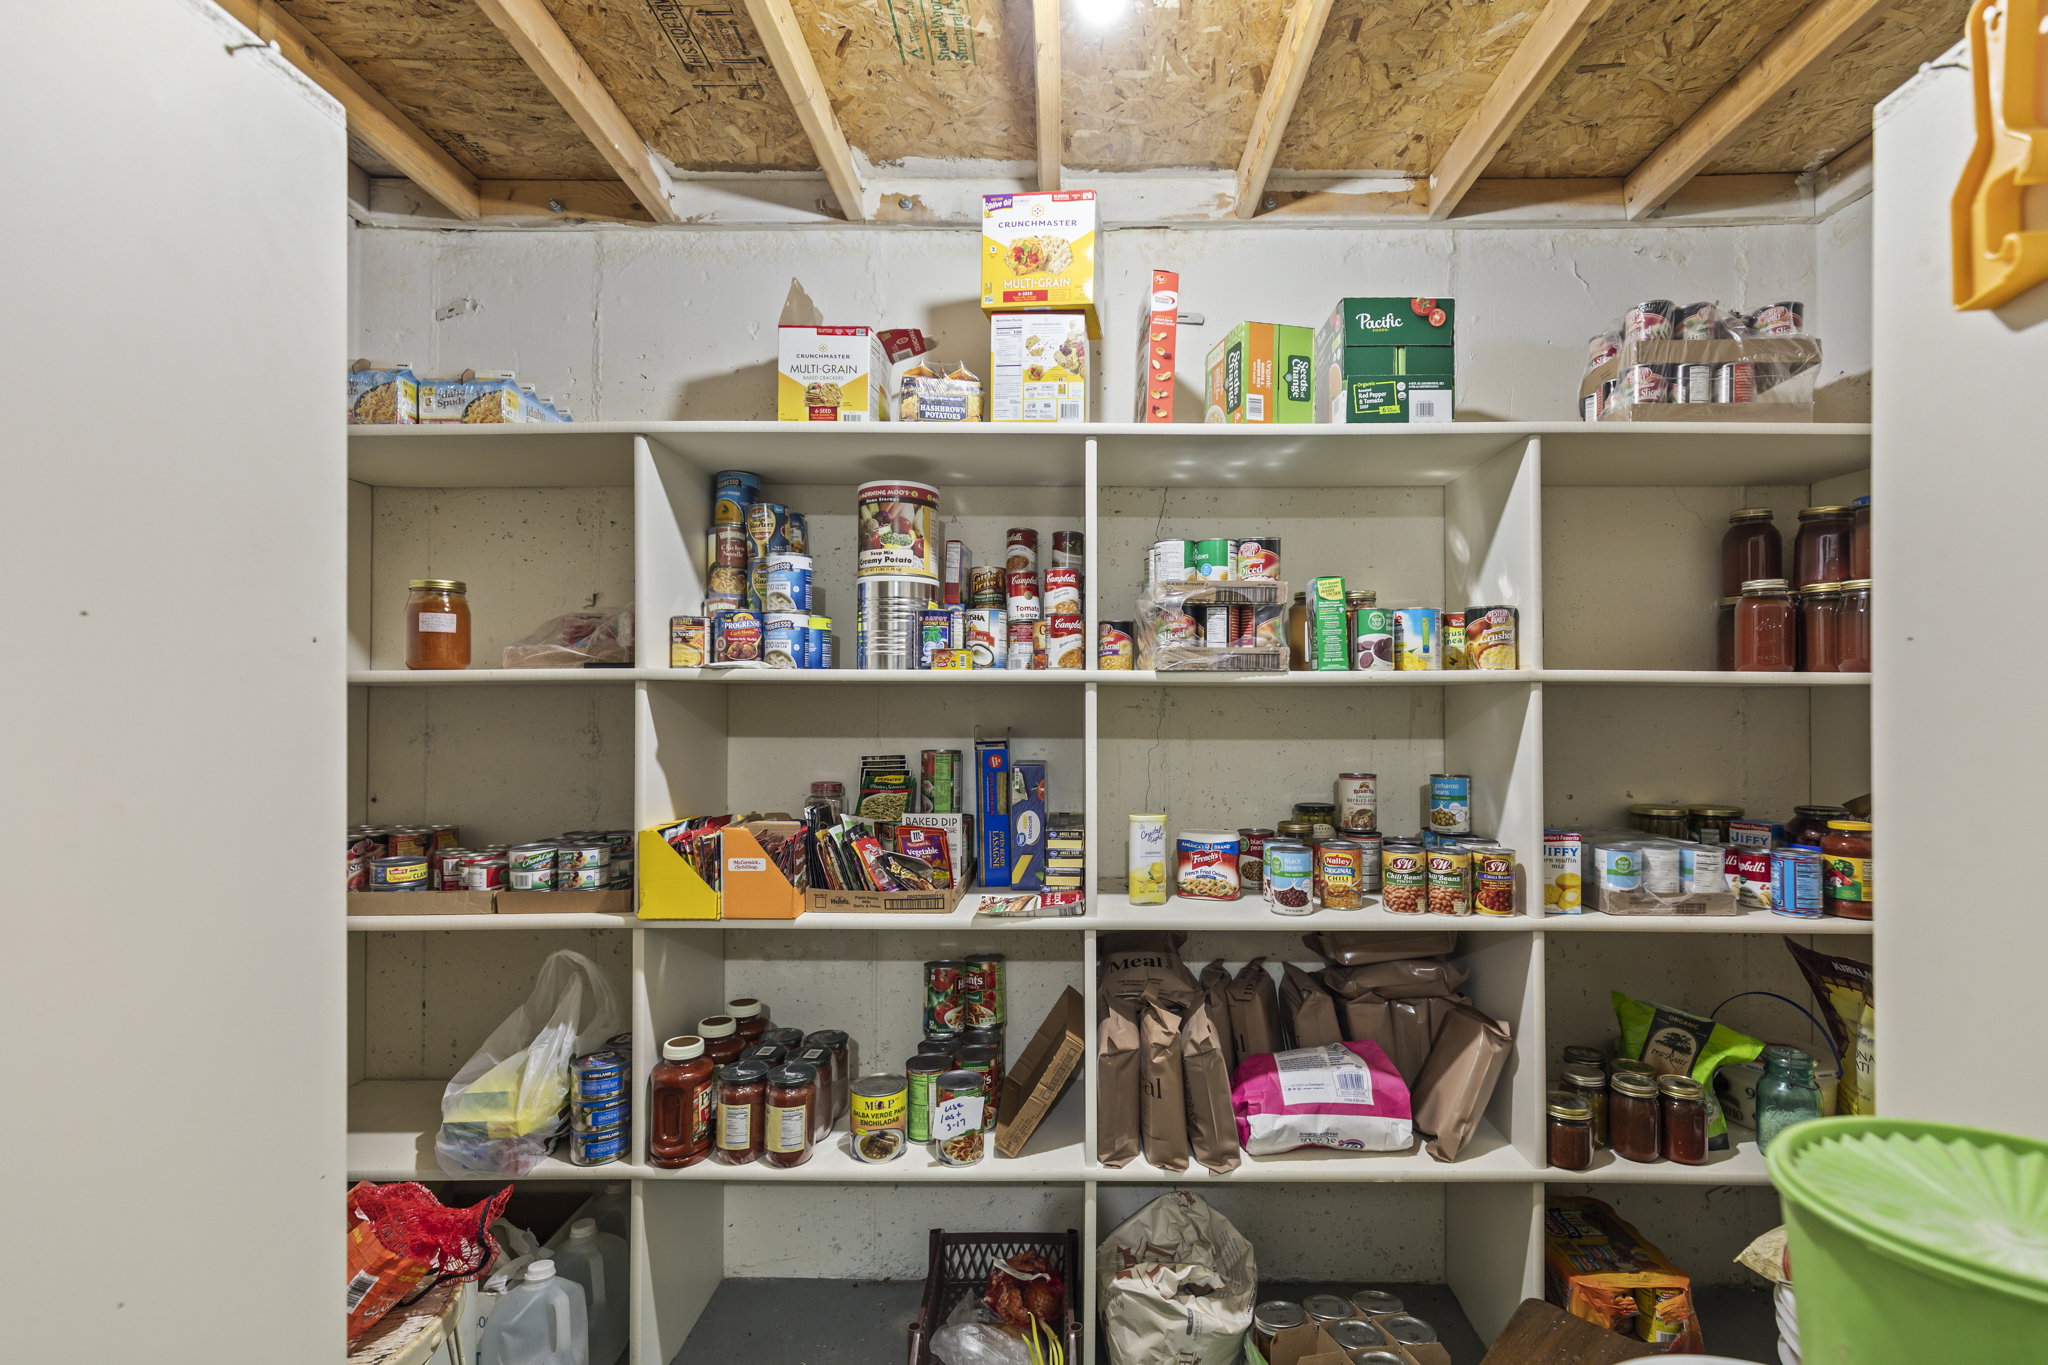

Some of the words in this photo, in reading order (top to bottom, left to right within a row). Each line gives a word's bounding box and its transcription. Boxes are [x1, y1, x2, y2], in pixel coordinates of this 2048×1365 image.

[666, 22, 692, 46] SIDE
[998, 220, 1078, 228] CRUNCHMASTER
[1003, 277, 1071, 288] MULTI-GRAIN
[1356, 312, 1404, 330] Pacific
[790, 364, 858, 374] MULTI-GRAIN
[1291, 358, 1302, 398] Change
[1300, 361, 1309, 392] Seeds
[437, 388, 466, 400] Idaho
[437, 398, 466, 408] Spuds
[920, 402, 966, 414] HASHBROWN
[924, 411, 961, 421] POTATOES
[861, 490, 886, 498] MORNING
[860, 558, 882, 566] Creamy
[884, 556, 912, 564] Potato
[1240, 564, 1263, 576] Diced
[1046, 572, 1076, 584] Campbell's
[1158, 630, 1186, 640] Sliced
[1480, 628, 1514, 643] Crushed
[906, 817, 938, 826] BAKED
[942, 818, 958, 826] DIP
[1140, 826, 1162, 842] Crystal
[1148, 832, 1164, 845] Light
[1731, 831, 1769, 846] JIFFY
[1182, 842, 1204, 850] AMERICA'S
[907, 847, 940, 858] Vegetable
[1192, 852, 1219, 864] French's
[1284, 856, 1302, 864] black
[1326, 857, 1352, 866] Nalley
[1184, 869, 1200, 878] French
[1212, 870, 1228, 879] Onions
[1438, 874, 1460, 882] Beans
[1110, 956, 1162, 974] Meal
[1668, 1015, 1700, 1030] ORGANIC
[871, 1110, 893, 1119] VERDE
[894, 1106, 906, 1116] PARA
[944, 1102, 964, 1112] use
[598, 1113, 617, 1122] CHICKEN
[860, 1116, 900, 1127] ENCHILADAS
[940, 1112, 962, 1124] last
[598, 1132, 620, 1140] KIRKLAND
[590, 1146, 609, 1154] CHICKEN
